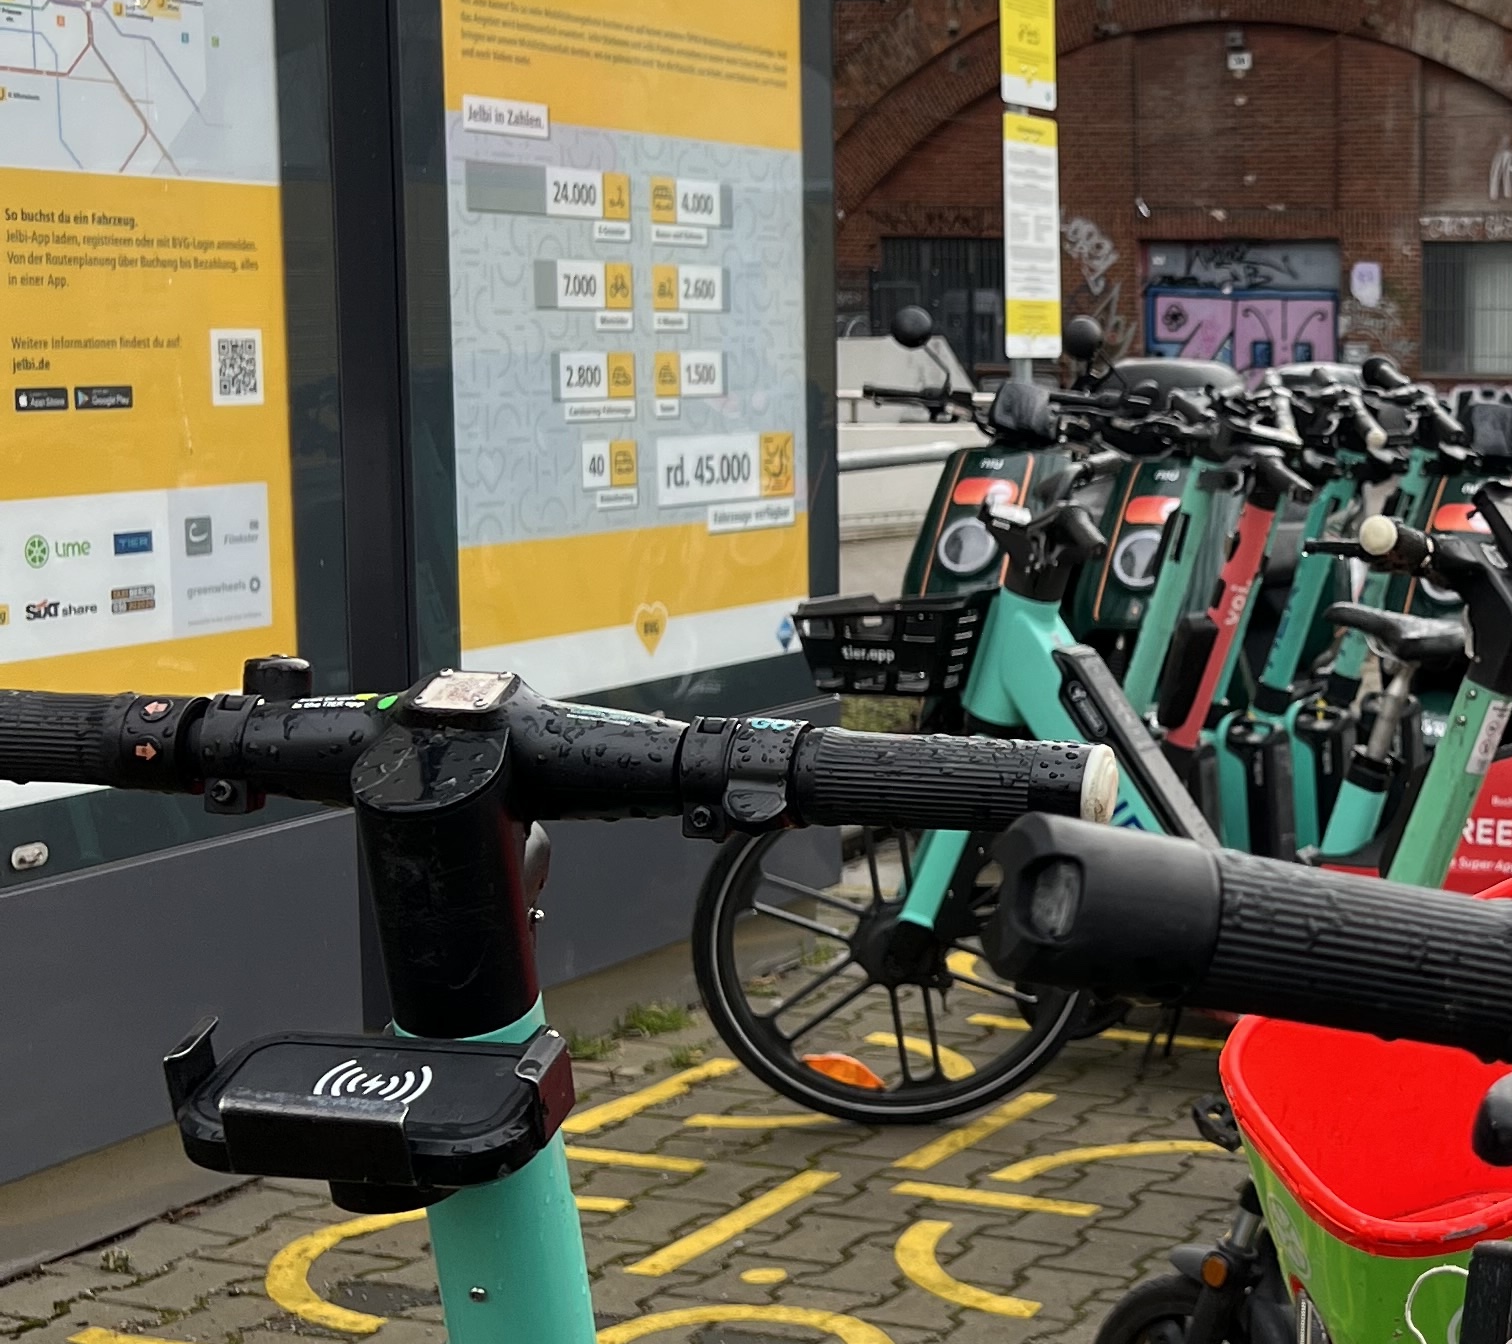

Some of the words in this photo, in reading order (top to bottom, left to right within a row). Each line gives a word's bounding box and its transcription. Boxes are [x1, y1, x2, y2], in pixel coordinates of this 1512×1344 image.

[467, 104, 492, 124] Jelbi
[495, 106, 505, 125] in
[507, 107, 544, 130] Zahlen.
[553, 181, 597, 206] 24.000
[681, 193, 714, 215] 4.000
[5, 208, 18, 223] So
[21, 208, 55, 224] buchst
[58, 209, 71, 224] du
[73, 210, 89, 225] ein
[91, 212, 138, 230] Fahrzeug.
[6, 229, 50, 247] Jelbi-App
[52, 231, 81, 247] laden,
[82, 233, 134, 250] registrieren
[7, 251, 26, 265] Von
[27, 251, 43, 266] der
[46, 253, 117, 272] Routenplanung
[8, 272, 17, 287] in
[20, 273, 45, 287] einer
[47, 273, 69, 290] App.
[563, 274, 597, 297] 7.000
[683, 277, 716, 301] 2.600
[12, 335, 48, 350] Weitere
[51, 335, 117, 350] Informationen
[119, 334, 150, 349] findest
[153, 334, 165, 348] du
[13, 356, 50, 374] jelbi.de
[686, 362, 716, 385] 1.500
[566, 364, 601, 388] 2.800
[91, 394, 114, 408] Google
[589, 454, 604, 478] 40
[666, 461, 690, 488] rd.
[694, 453, 751, 486] 45.000
[54, 539, 91, 559] Lime
[118, 538, 149, 549] TIER
[186, 579, 247, 599] greenwheels
[61, 603, 98, 618] share
[841, 644, 895, 665] tier.app
[1458, 856, 1493, 873] Super
